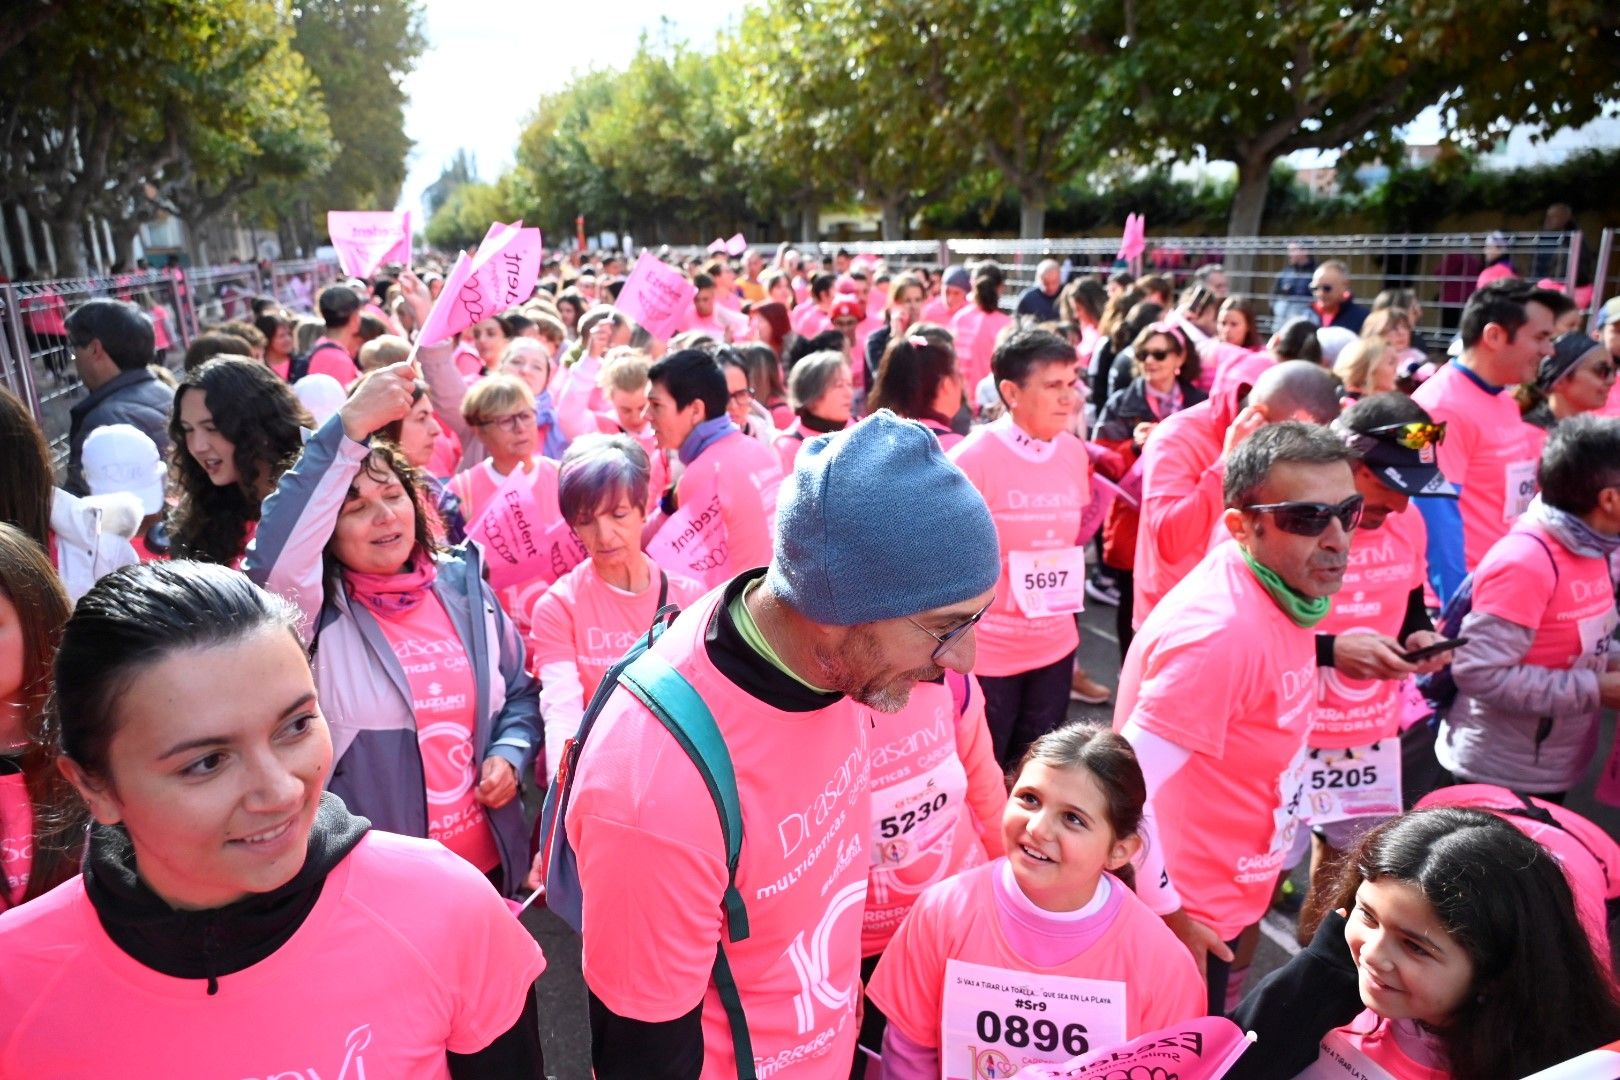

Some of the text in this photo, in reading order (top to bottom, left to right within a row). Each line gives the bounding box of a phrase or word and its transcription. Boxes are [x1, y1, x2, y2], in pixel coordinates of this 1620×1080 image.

[505, 490, 537, 558] Ezedent
[1025, 571, 1069, 590] 5697
[392, 638, 464, 657] asanv
[587, 626, 637, 650] Dras
[872, 706, 946, 769] asanvi
[1311, 765, 1378, 789] 5205
[880, 793, 948, 839] 5230
[1015, 998, 1047, 1012] #Sr9
[1043, 991, 1056, 999] QUE
[1070, 994, 1080, 1002] EN
[1090, 996, 1112, 1004] PLAYA
[976, 1010, 1089, 1057] 0896
